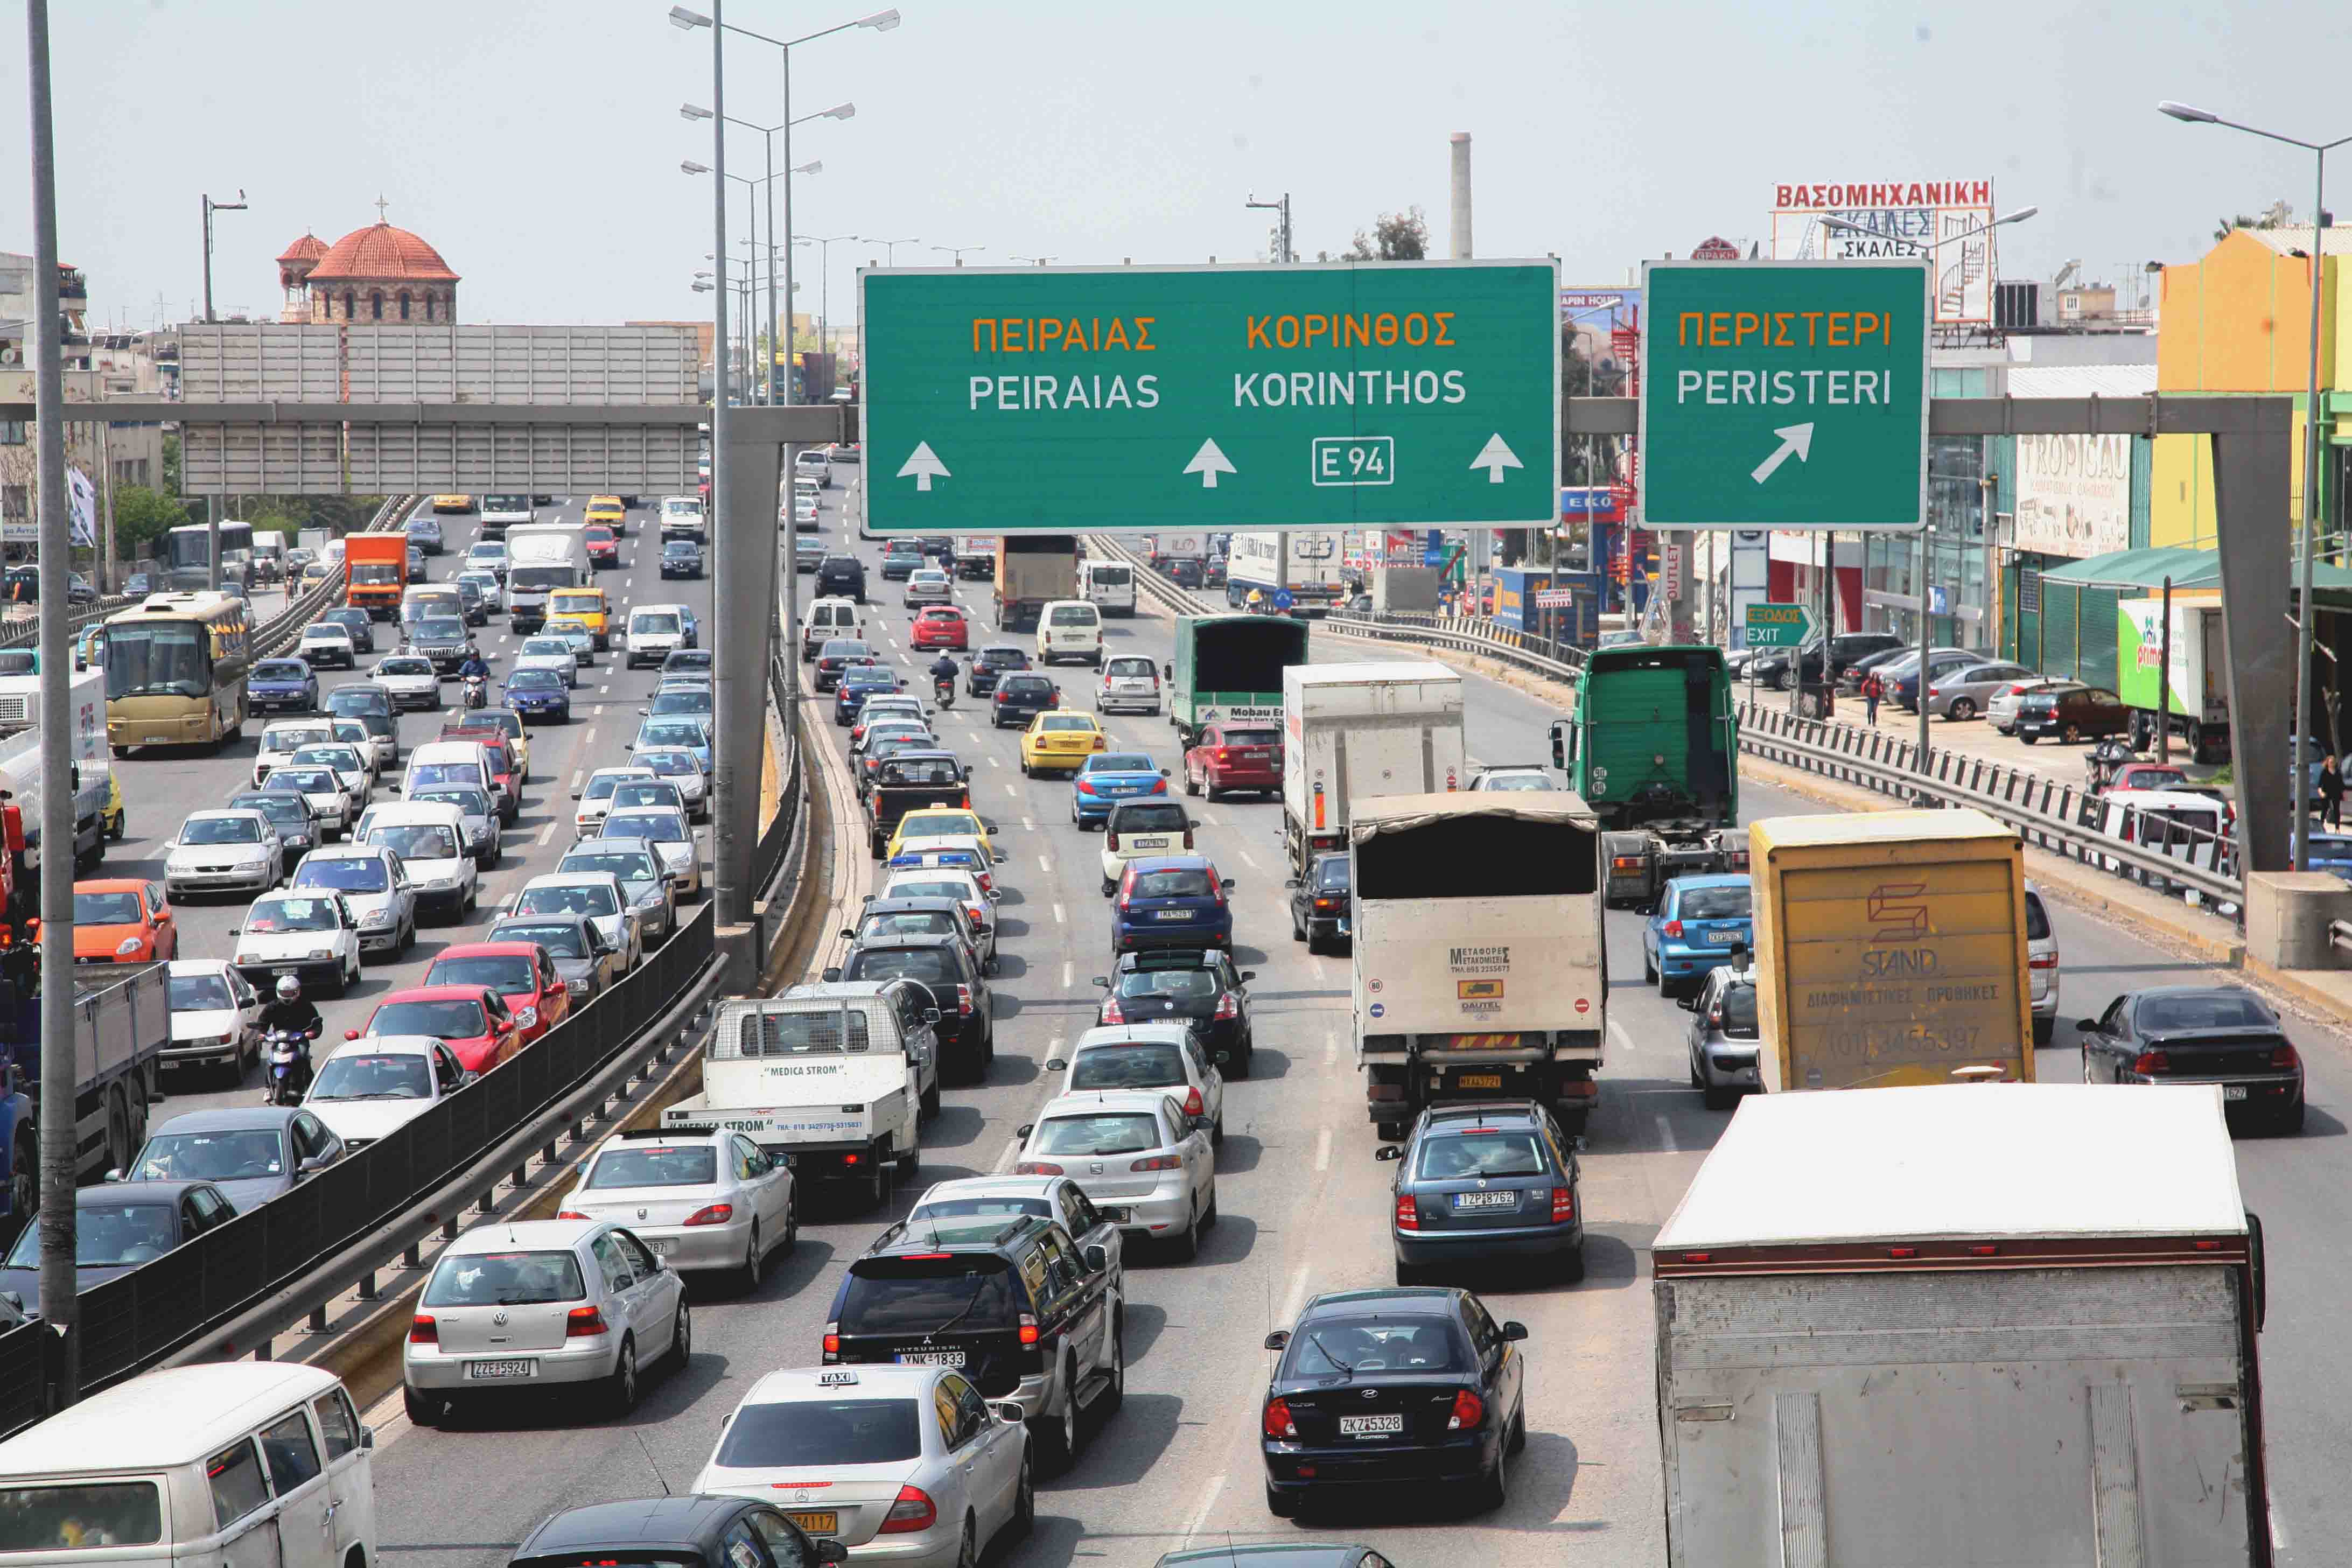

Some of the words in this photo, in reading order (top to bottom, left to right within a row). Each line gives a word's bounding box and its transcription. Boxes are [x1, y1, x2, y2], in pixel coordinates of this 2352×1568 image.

[1776, 180, 1989, 207] ΒΑΣΟΜΗΧΑΝΙΚΗ
[1845, 240, 1917, 257] ΣΚΑΛΕΣ
[972, 316, 1157, 353] ΠΕΙΡΑΙΑΣ
[1247, 312, 1455, 349] ΚΟΡΙΝΘΟΣ
[1678, 312, 1891, 347] ΠΕΡΙΣΤΕΡΙ
[969, 374, 1160, 410] PEIRAIAS
[1235, 369, 1466, 407] KORINTHOS
[1678, 369, 1890, 404] PERISTERI
[1322, 447, 1340, 477] E
[1348, 446, 1384, 475] 94
[2021, 434, 2126, 479] TROPICAL
[1668, 546, 1678, 599] OUTLET
[1748, 608, 1800, 622] ΕΞΟΔΟΣ
[1748, 628, 1779, 642] EXIT
[1231, 708, 1270, 717] Mobau
[1863, 949, 1937, 975] STAND
[1371, 981, 1380, 990] 80
[823, 1373, 850, 1383] TAXI
